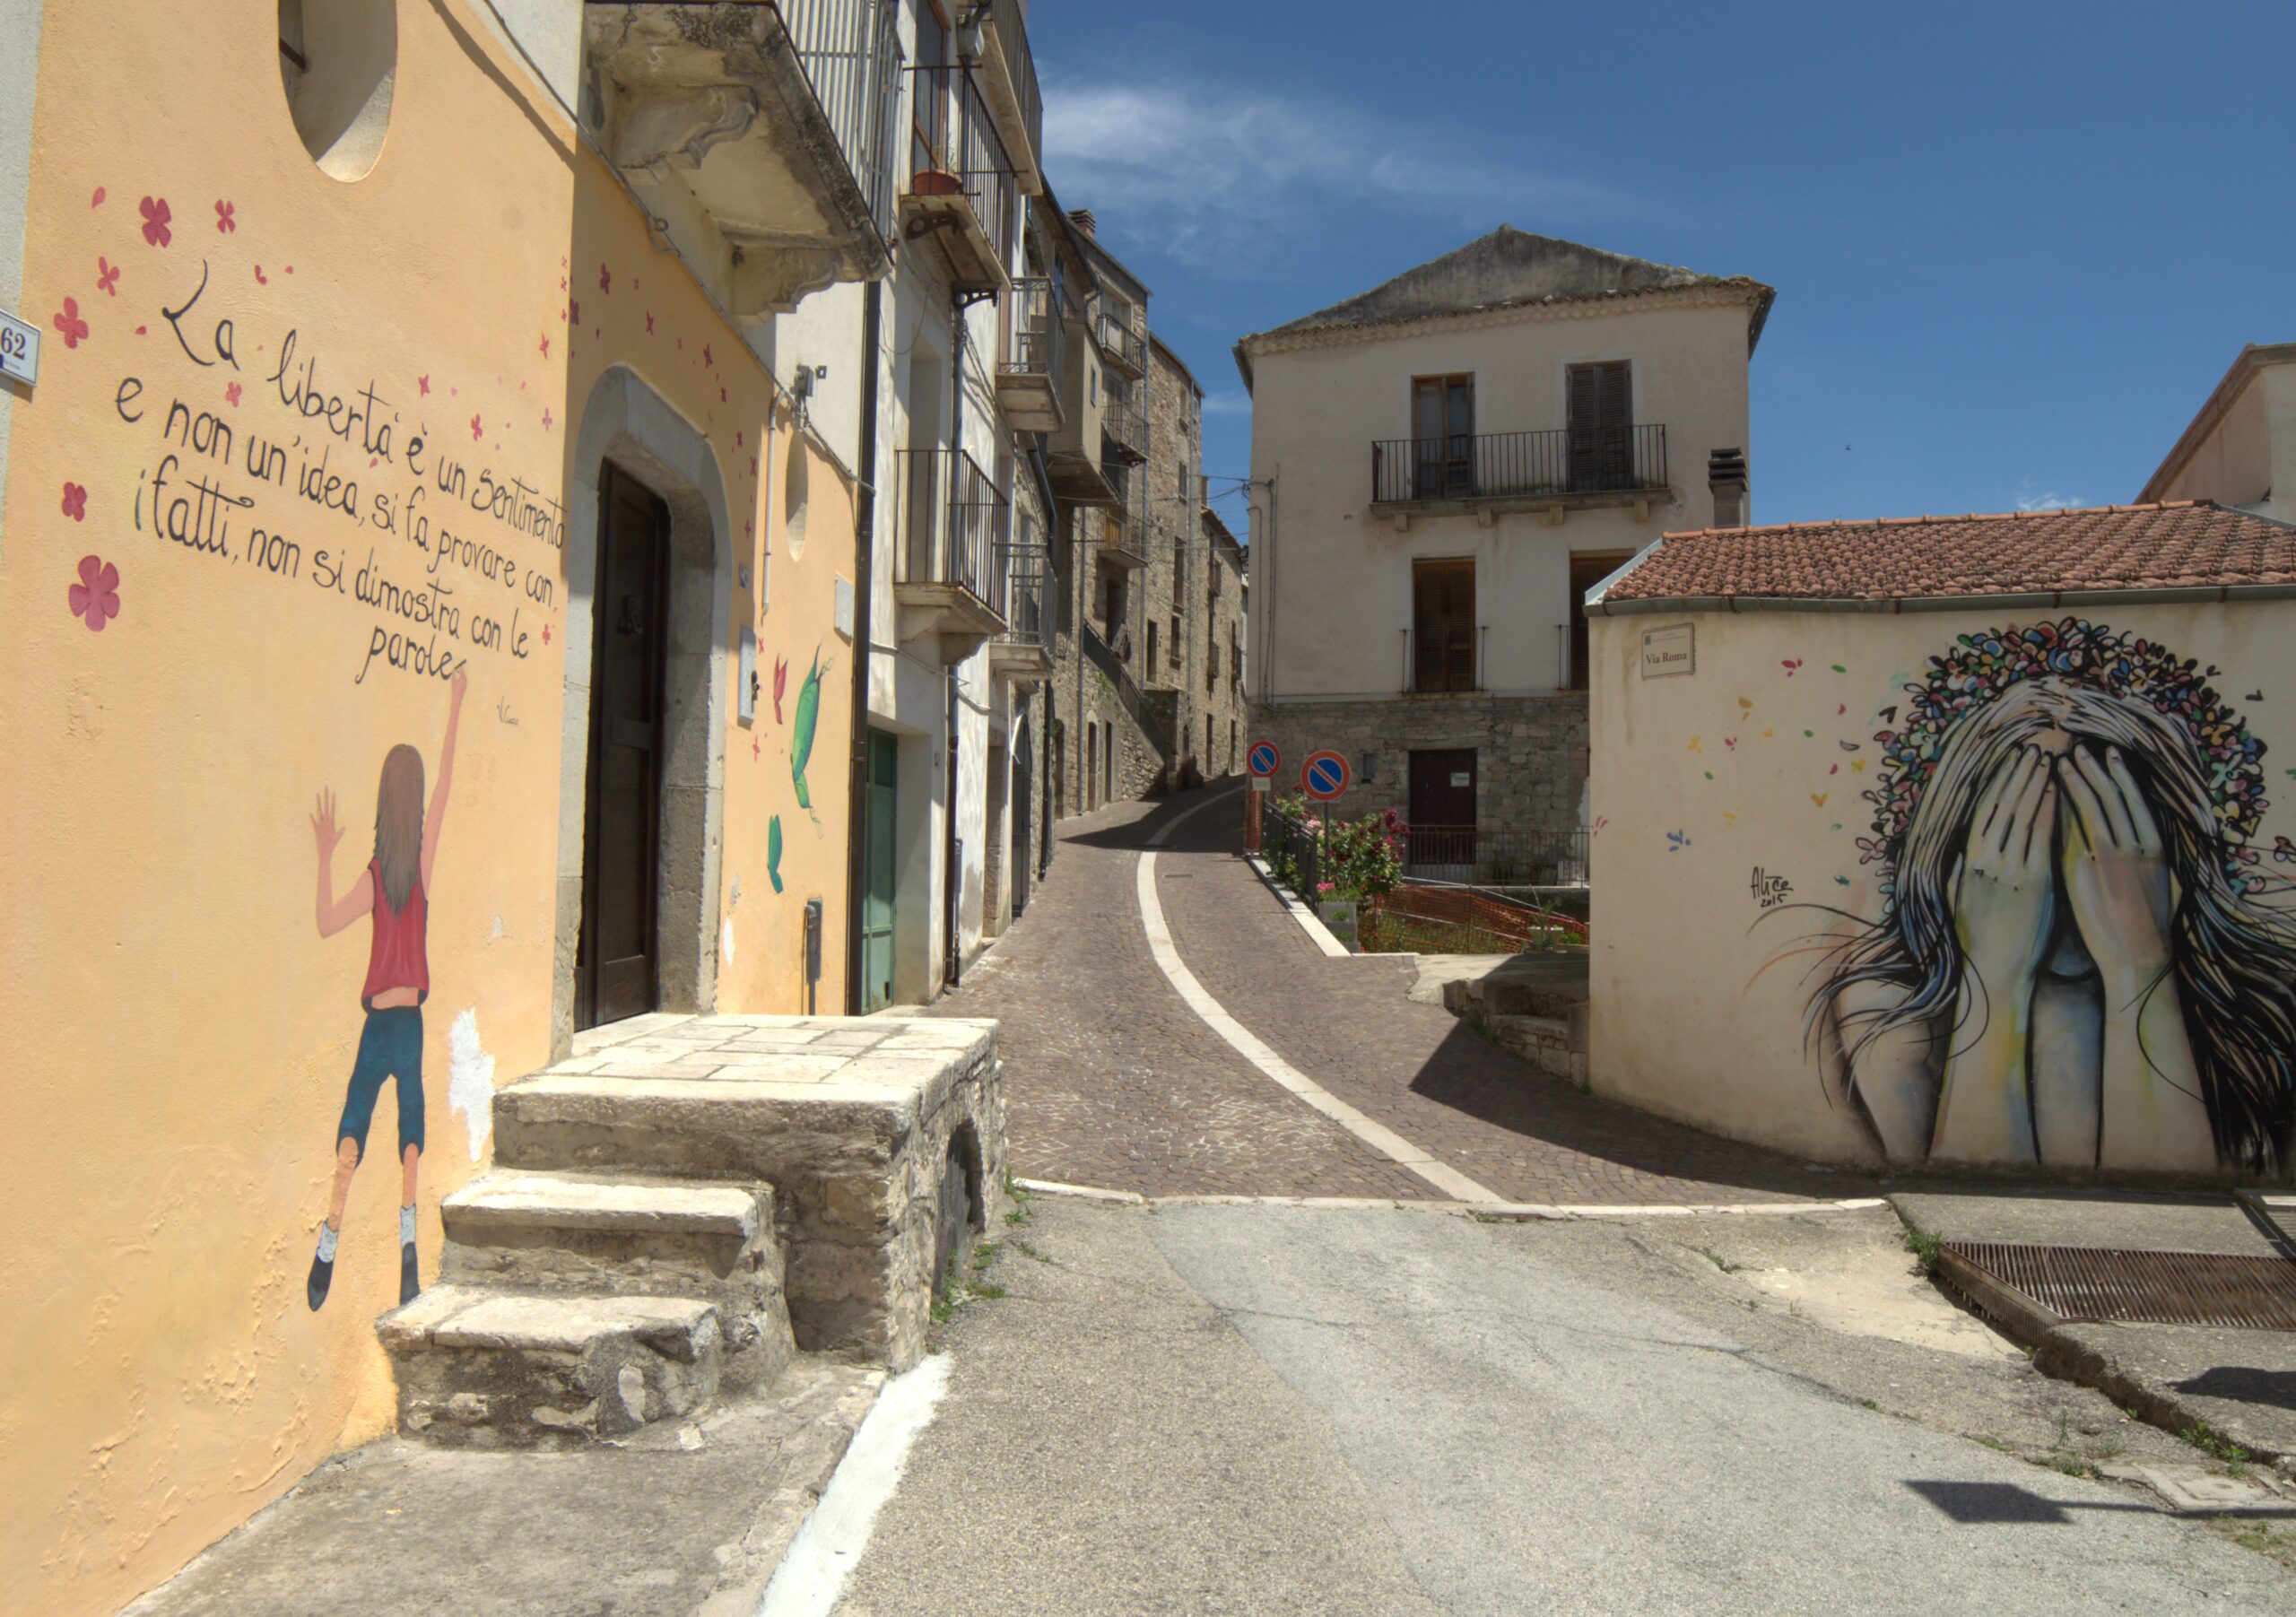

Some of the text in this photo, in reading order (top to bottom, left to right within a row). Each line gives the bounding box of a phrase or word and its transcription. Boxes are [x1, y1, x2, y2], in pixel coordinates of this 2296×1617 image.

[1, 327, 26, 361] 62
[161, 257, 241, 372] La
[406, 422, 429, 475] è
[438, 456, 466, 501] un
[115, 377, 144, 423] e
[164, 397, 232, 465] non
[406, 485, 430, 552] fa
[427, 528, 517, 588] provare
[526, 569, 553, 608] con
[135, 468, 146, 531] i
[248, 527, 300, 578] non
[355, 546, 460, 639] dimostra
[472, 615, 501, 652] con
[511, 607, 529, 659] le
[1645, 651, 1688, 665] Via Roma
